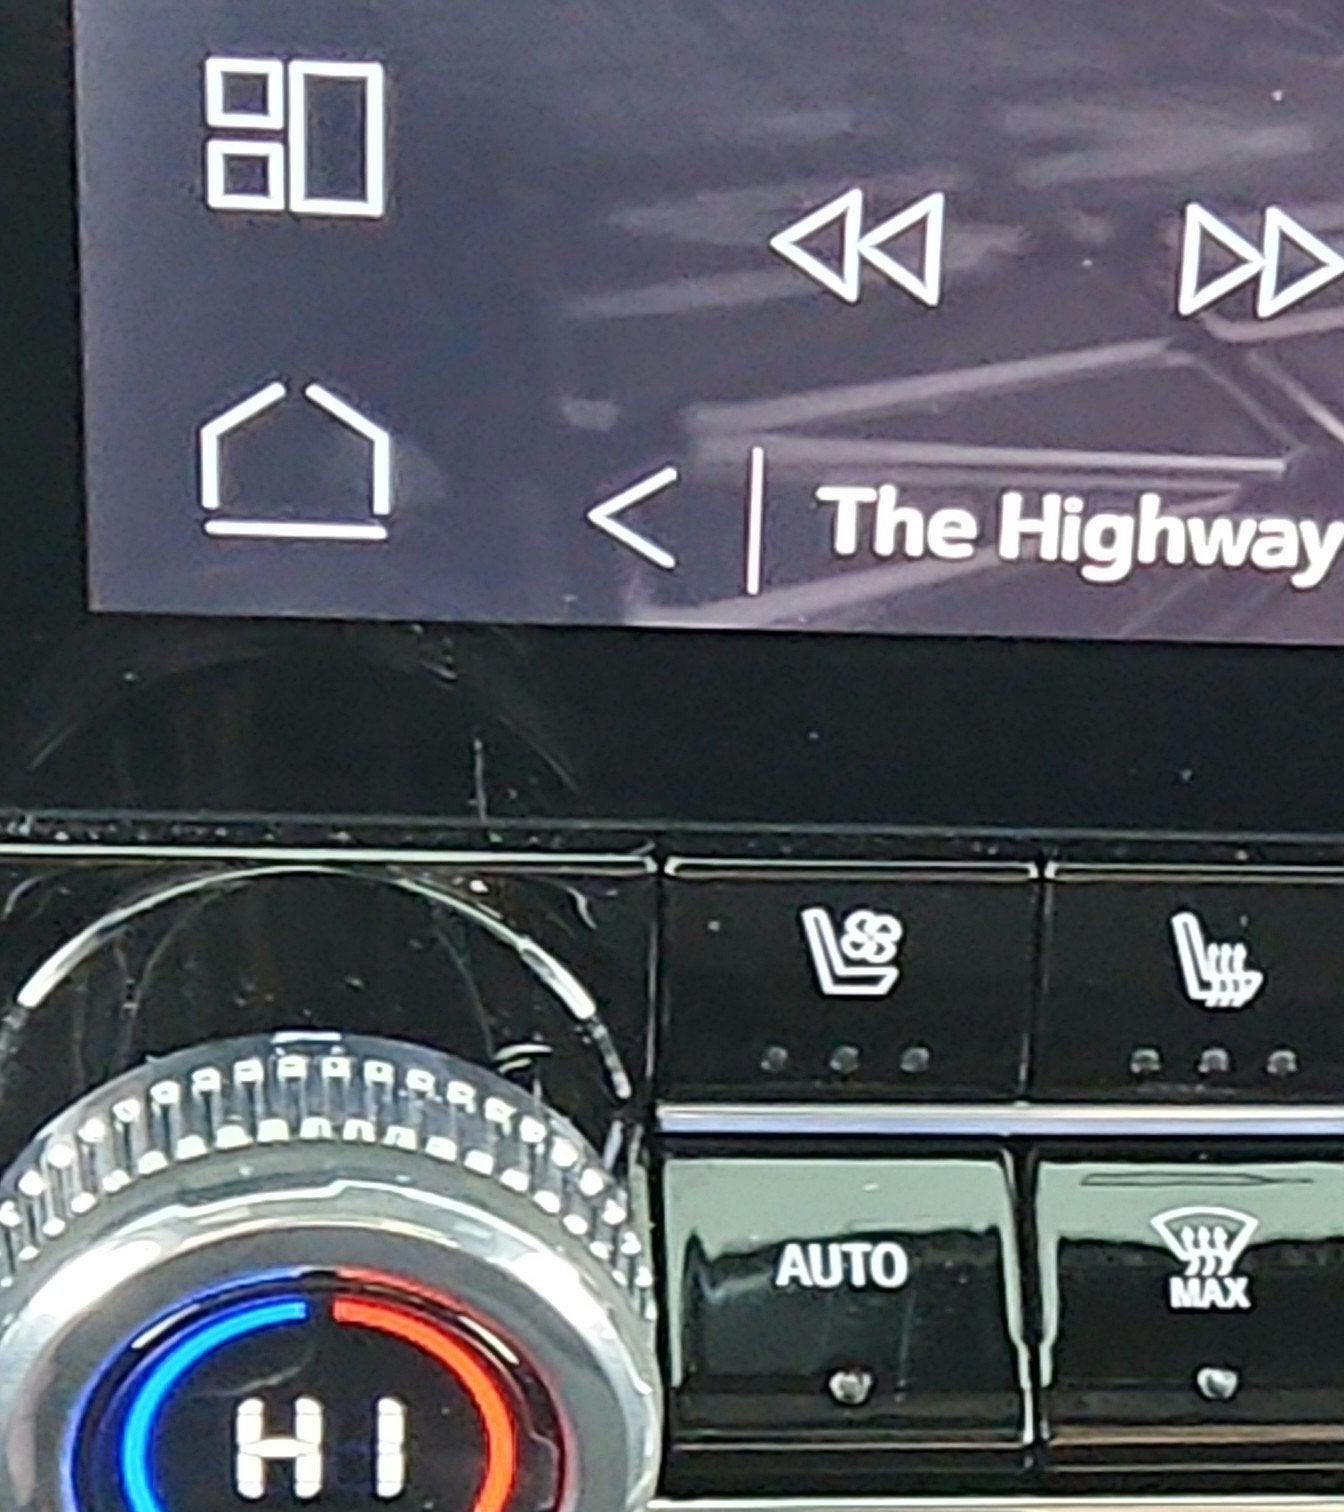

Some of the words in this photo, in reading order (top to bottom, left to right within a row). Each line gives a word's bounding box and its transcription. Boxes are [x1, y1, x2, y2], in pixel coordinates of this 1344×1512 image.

[817, 484, 977, 560] The
[774, 1242, 909, 1290] AUTO
[1169, 1275, 1251, 1311] MAX
